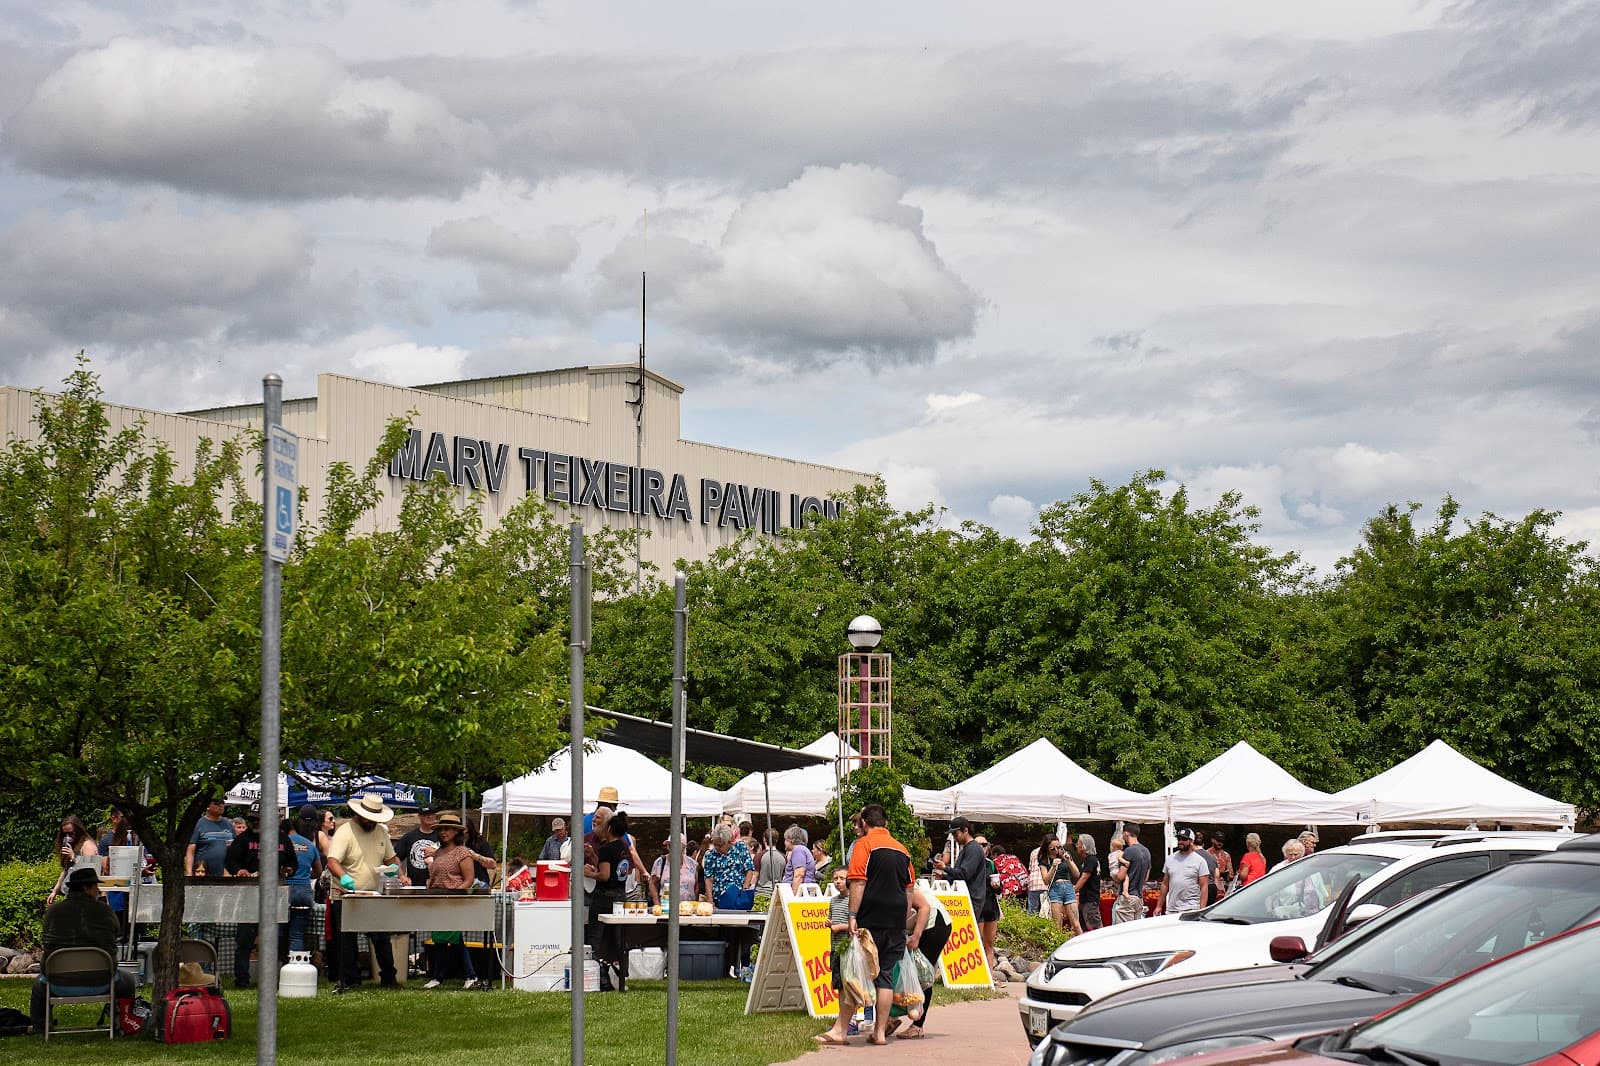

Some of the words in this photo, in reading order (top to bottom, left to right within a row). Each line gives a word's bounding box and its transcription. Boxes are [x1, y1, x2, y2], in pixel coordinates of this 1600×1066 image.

[388, 428, 510, 493] MARV
[519, 447, 693, 522] TEIXEIRA
[796, 921, 827, 931] FUNDR
[801, 908, 829, 918] CHURC
[805, 950, 833, 982] TAC
[946, 948, 983, 982] TACOS
